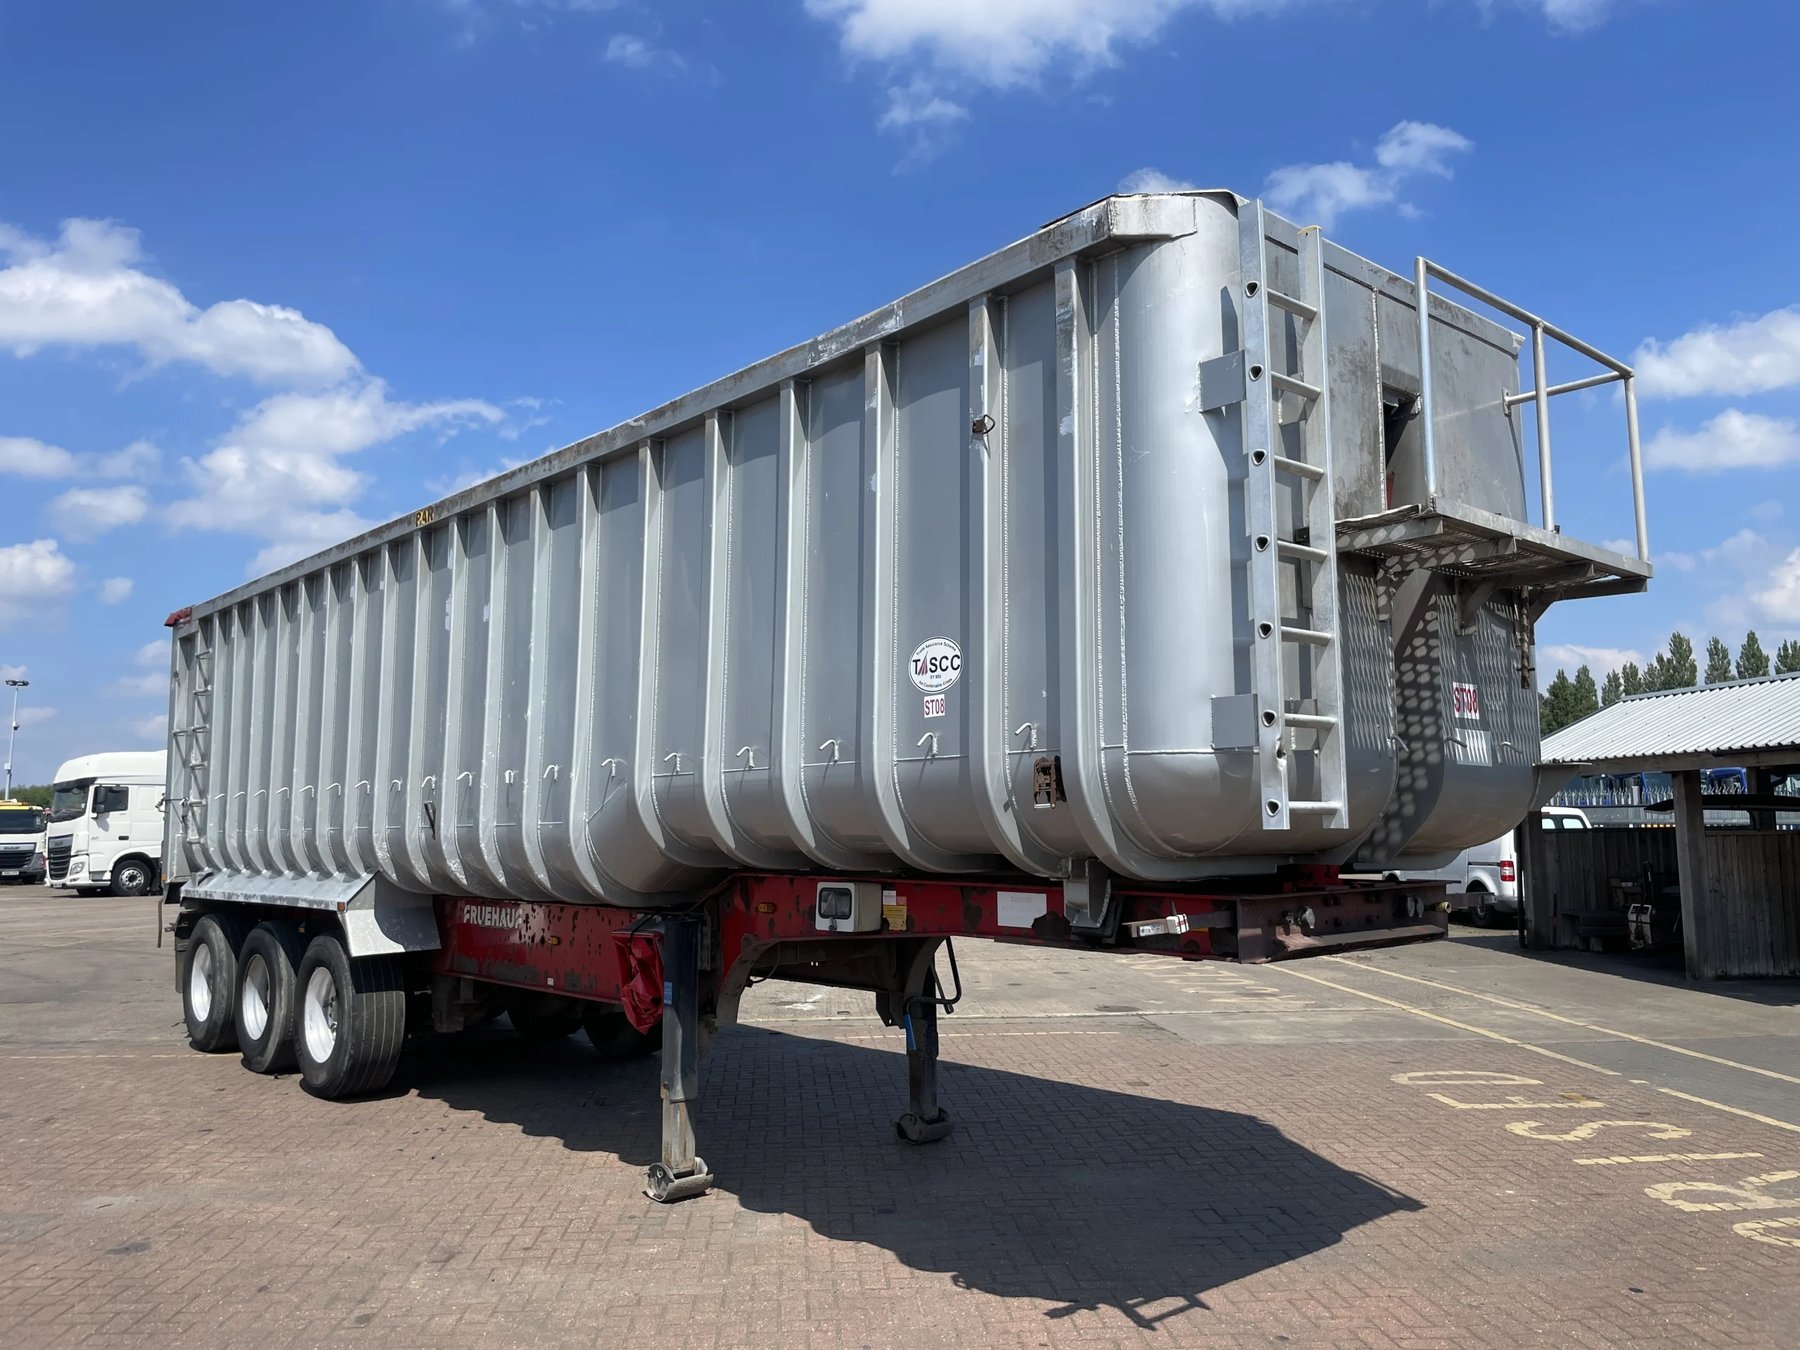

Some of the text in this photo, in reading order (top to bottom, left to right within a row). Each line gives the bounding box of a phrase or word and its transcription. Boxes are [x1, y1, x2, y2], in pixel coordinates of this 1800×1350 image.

[912, 652, 961, 676] TASCC
[924, 698, 945, 716] ST08
[1453, 686, 1478, 714] ST08
